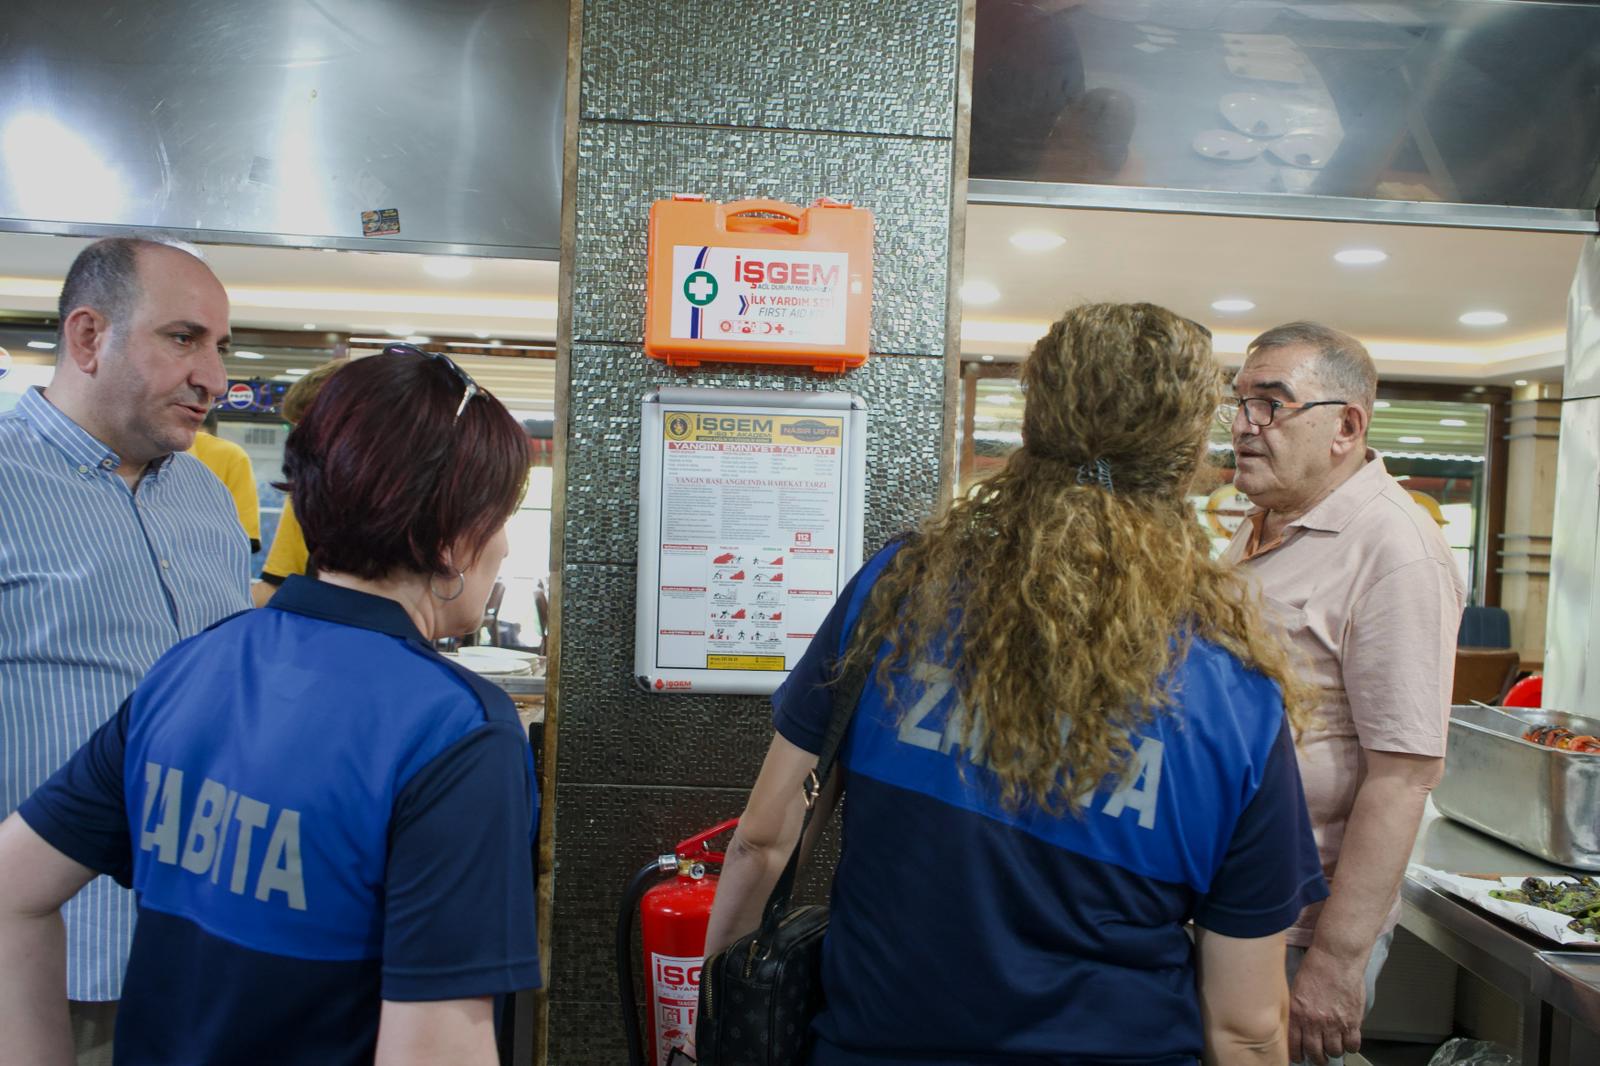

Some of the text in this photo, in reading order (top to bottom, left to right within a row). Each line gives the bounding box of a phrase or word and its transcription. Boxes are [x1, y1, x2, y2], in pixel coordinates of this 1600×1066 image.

[769, 295, 810, 307] YARDIM
[758, 307, 787, 318] FIRST
[673, 441, 720, 451] YANGIN
